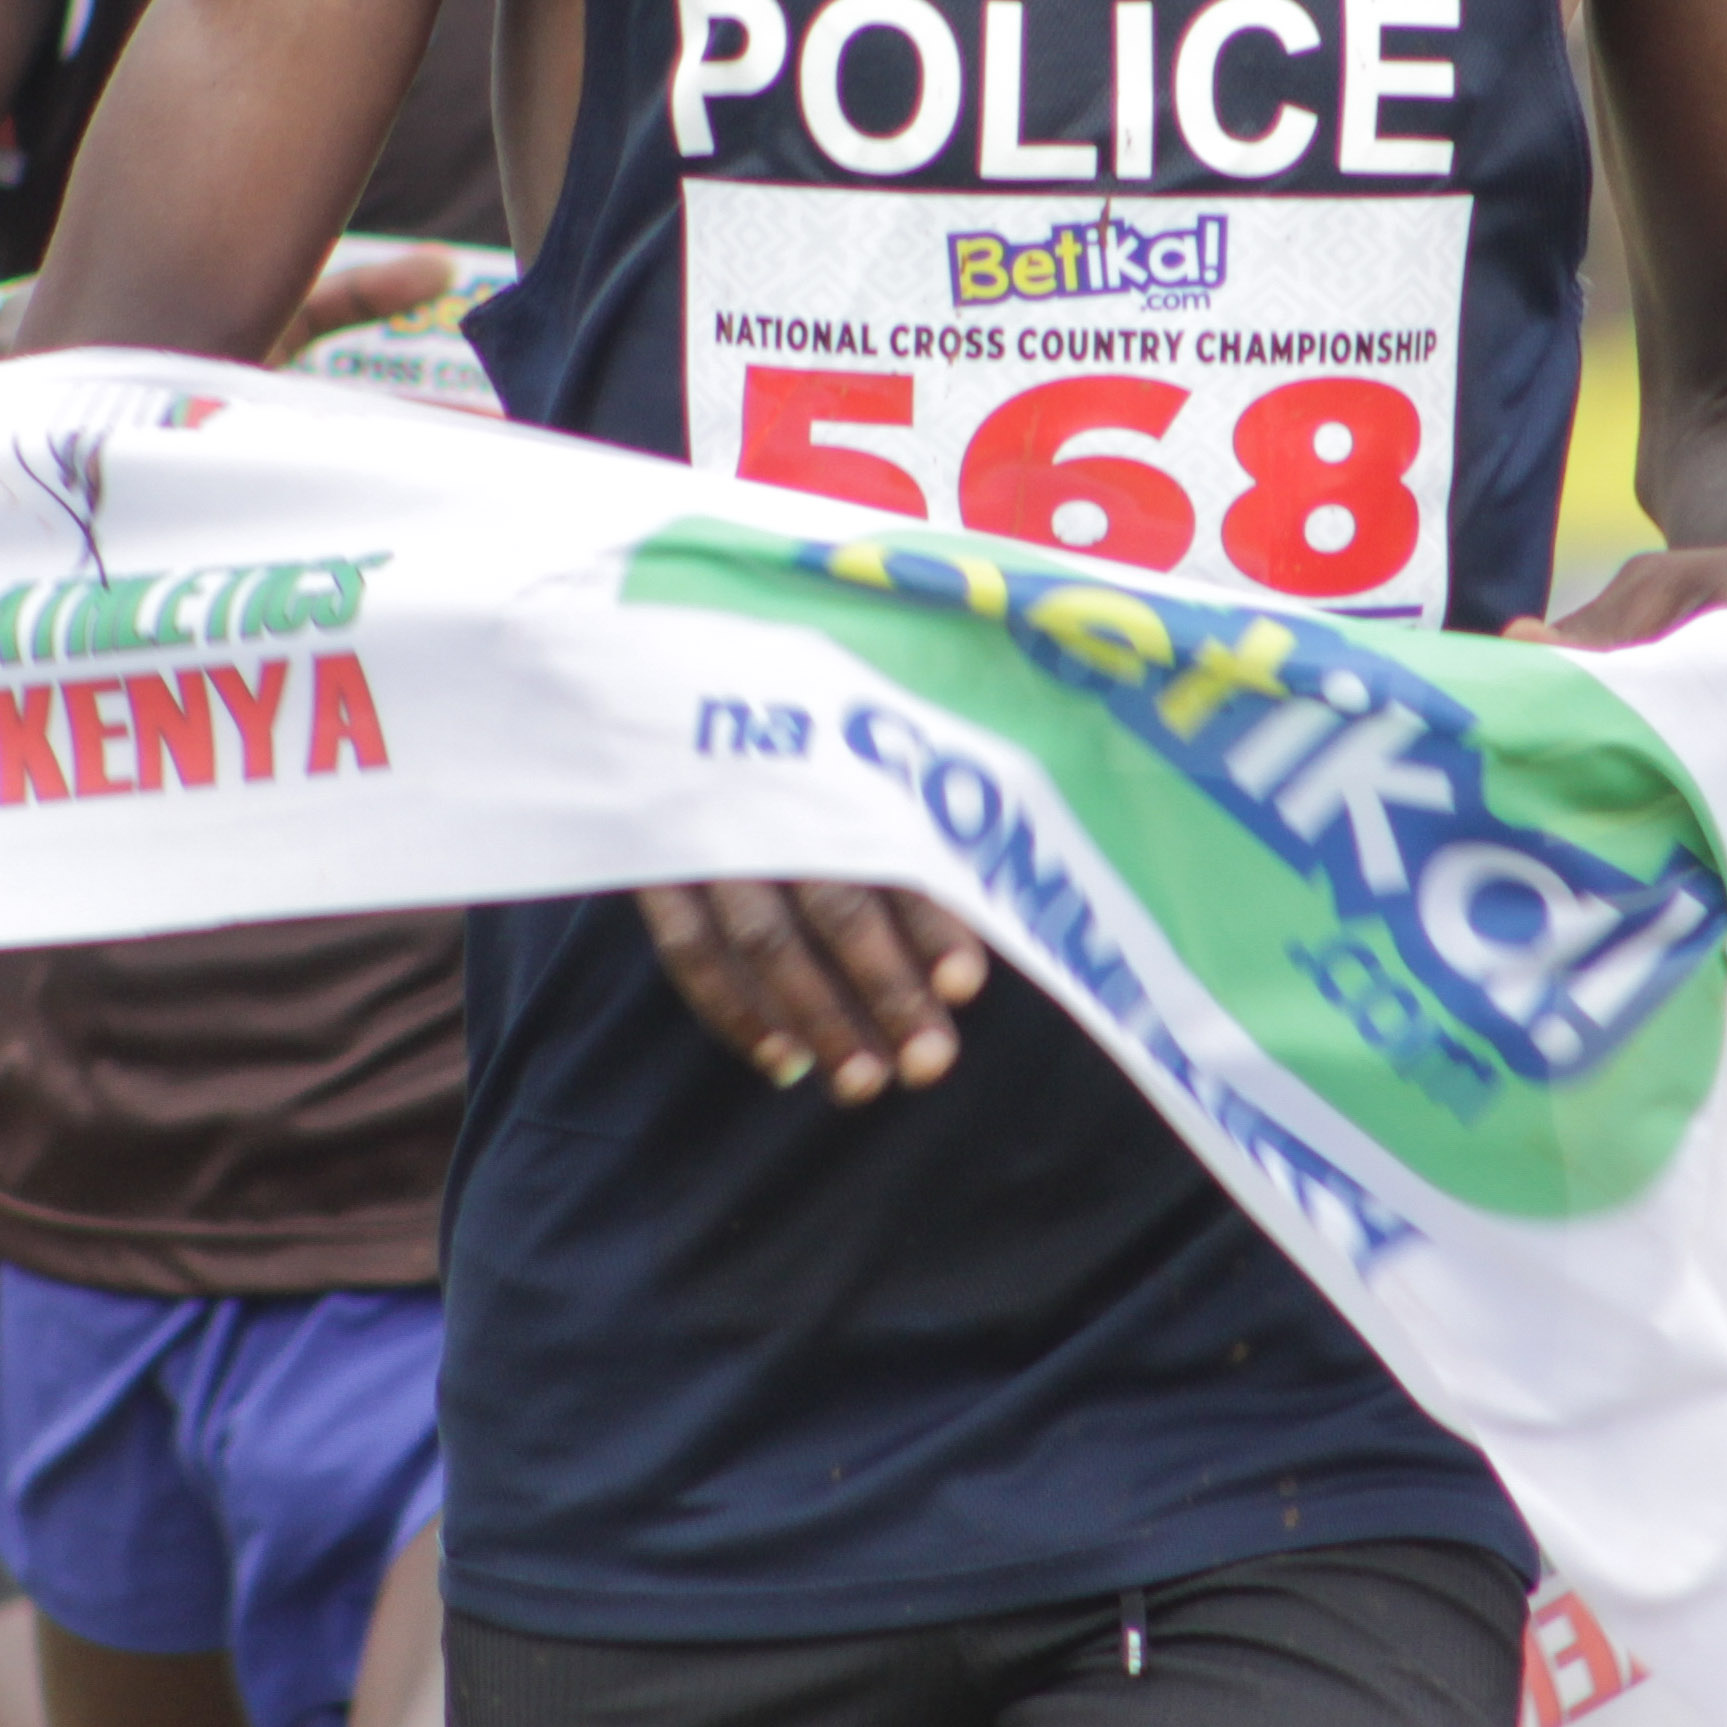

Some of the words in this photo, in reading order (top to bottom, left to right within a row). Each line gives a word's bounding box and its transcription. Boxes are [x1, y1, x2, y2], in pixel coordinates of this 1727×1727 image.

[950, 215, 1228, 308] Betika!
[715, 309, 878, 357] NATIONAL
[889, 324, 1005, 364] CROSS
[1017, 328, 1184, 364] COUNTRY
[1195, 328, 1438, 366] CHAMPIONSHIP
[737, 366, 1421, 598] 568
[694, 697, 814, 760] na
